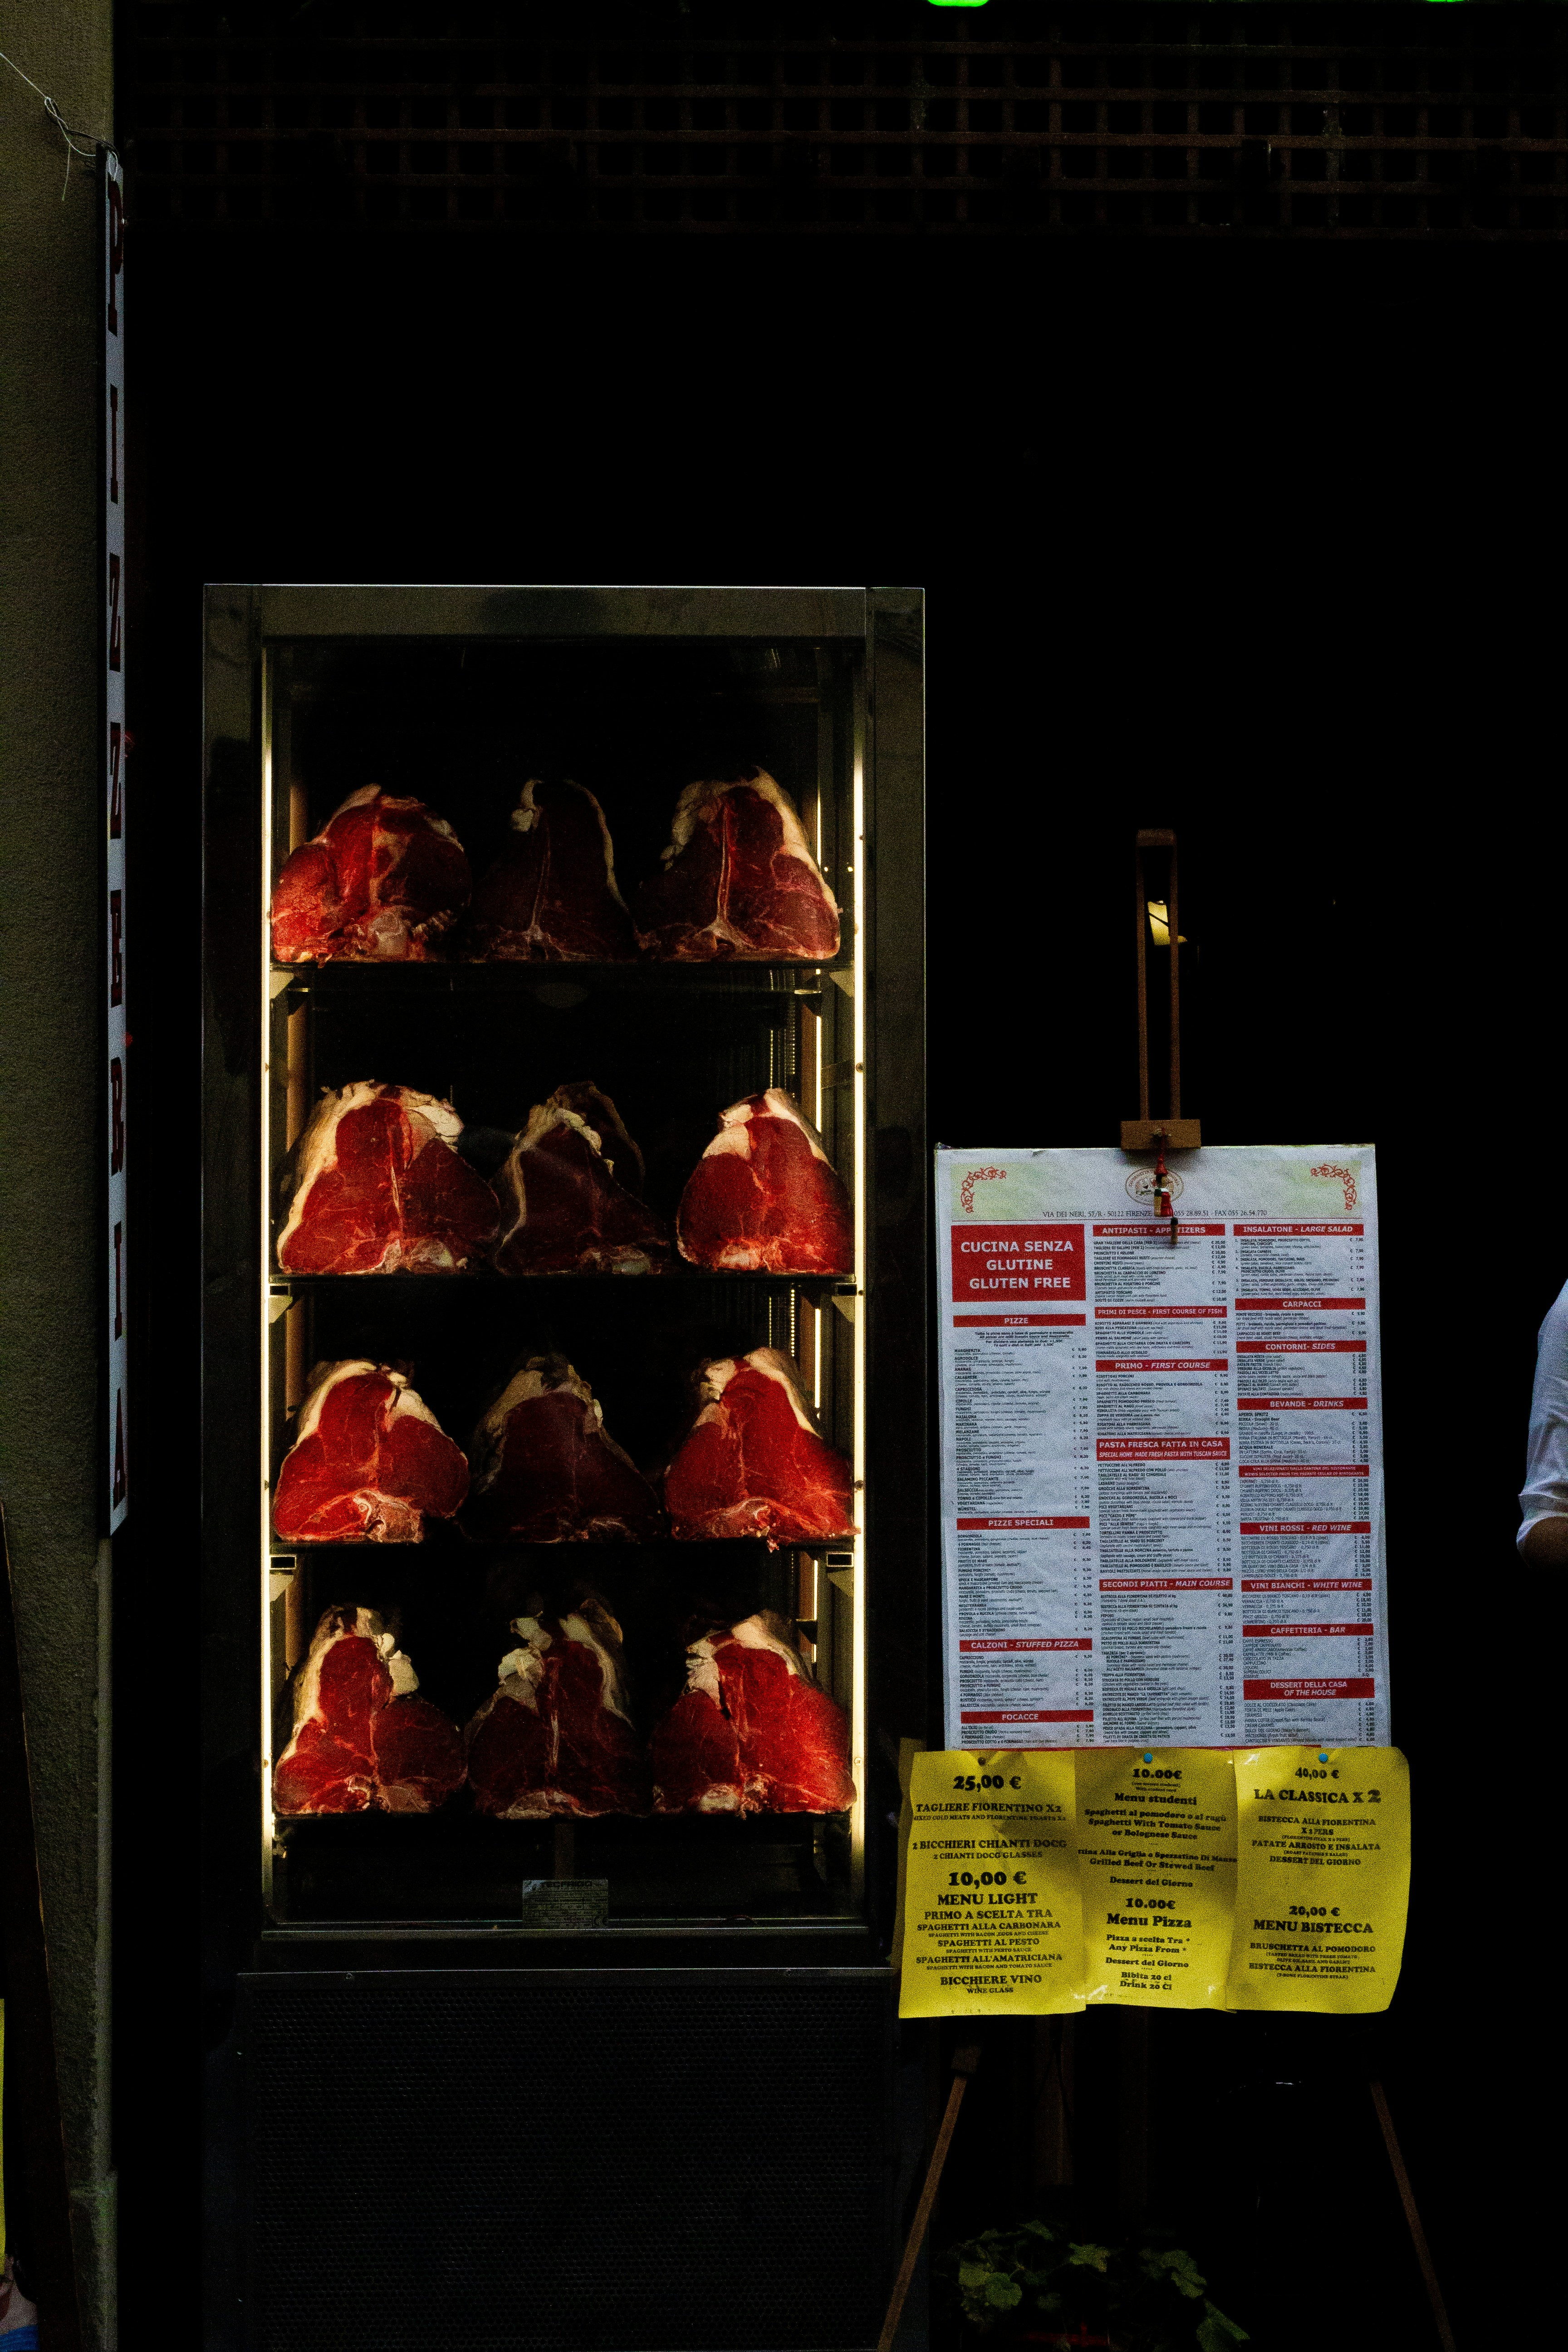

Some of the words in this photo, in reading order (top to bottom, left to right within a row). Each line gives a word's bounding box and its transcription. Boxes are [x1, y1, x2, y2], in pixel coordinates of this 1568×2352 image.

[108, 172, 128, 1511] PIZZERIA
[960, 1241, 1019, 1253] CUCINA
[1024, 1240, 1074, 1252] SENZA
[986, 1259, 1053, 1271] GLUTINE
[969, 1277, 1029, 1289] GLUTEN
[1034, 1277, 1071, 1288] FREE
[1132, 1769, 1182, 1779] 10.00€
[1295, 1767, 1327, 1779] 40,00
[1331, 1769, 1339, 1779] €
[953, 1775, 1004, 1792] 25,00
[1009, 1776, 1021, 1789] €
[1115, 1793, 1145, 1802] Menu
[1148, 1795, 1197, 1805] studenti
[1254, 1789, 1274, 1800] LA
[1279, 1789, 1349, 1803] CLASSICA
[1352, 1792, 1363, 1803] X
[1368, 1789, 1381, 1803] 2
[916, 1803, 970, 1812] TAGLIERE
[972, 1803, 1043, 1812] FIORENTINO
[1046, 1804, 1062, 1813] X2
[1158, 1821, 1192, 1829] Tomato
[920, 1840, 975, 1849] BICCHIERI
[978, 1839, 1030, 1849] CHIANTI
[1033, 1839, 1067, 1847] DOCG
[948, 1872, 1007, 1889] 10,00
[1013, 1871, 1027, 1885] €
[1161, 1879, 1193, 1887] Giorno
[938, 1893, 984, 1905] MENU
[988, 1892, 1038, 1904] LIGHT
[1126, 1898, 1176, 1910] 10.00€
[925, 1911, 961, 1920] PRIMO
[965, 1911, 974, 1919] A
[977, 1910, 1023, 1919] SCELTA
[1027, 1909, 1053, 1918] TRA
[1289, 1906, 1327, 1918] 20,00
[1331, 1907, 1340, 1916] €
[1107, 1913, 1148, 1926] Menu
[1152, 1916, 1192, 1928] Pizza
[1254, 1920, 1298, 1931] MENU
[1301, 1922, 1373, 1933] BISTECCA
[937, 1939, 991, 1947] SPAGHETTI
[1250, 1943, 1309, 1951] BRUSCHETTA
[916, 1956, 970, 1964] SPAGHETTI
[972, 1954, 1063, 1963] ALL'AMATRICIANA
[1106, 1957, 1139, 1965] Dessert
[1249, 1963, 1292, 1971] BISTECCA
[940, 1975, 1007, 1985] BICCHIERE
[1011, 1975, 1042, 1984] VINO
[1121, 1972, 1149, 1980] Bibita
